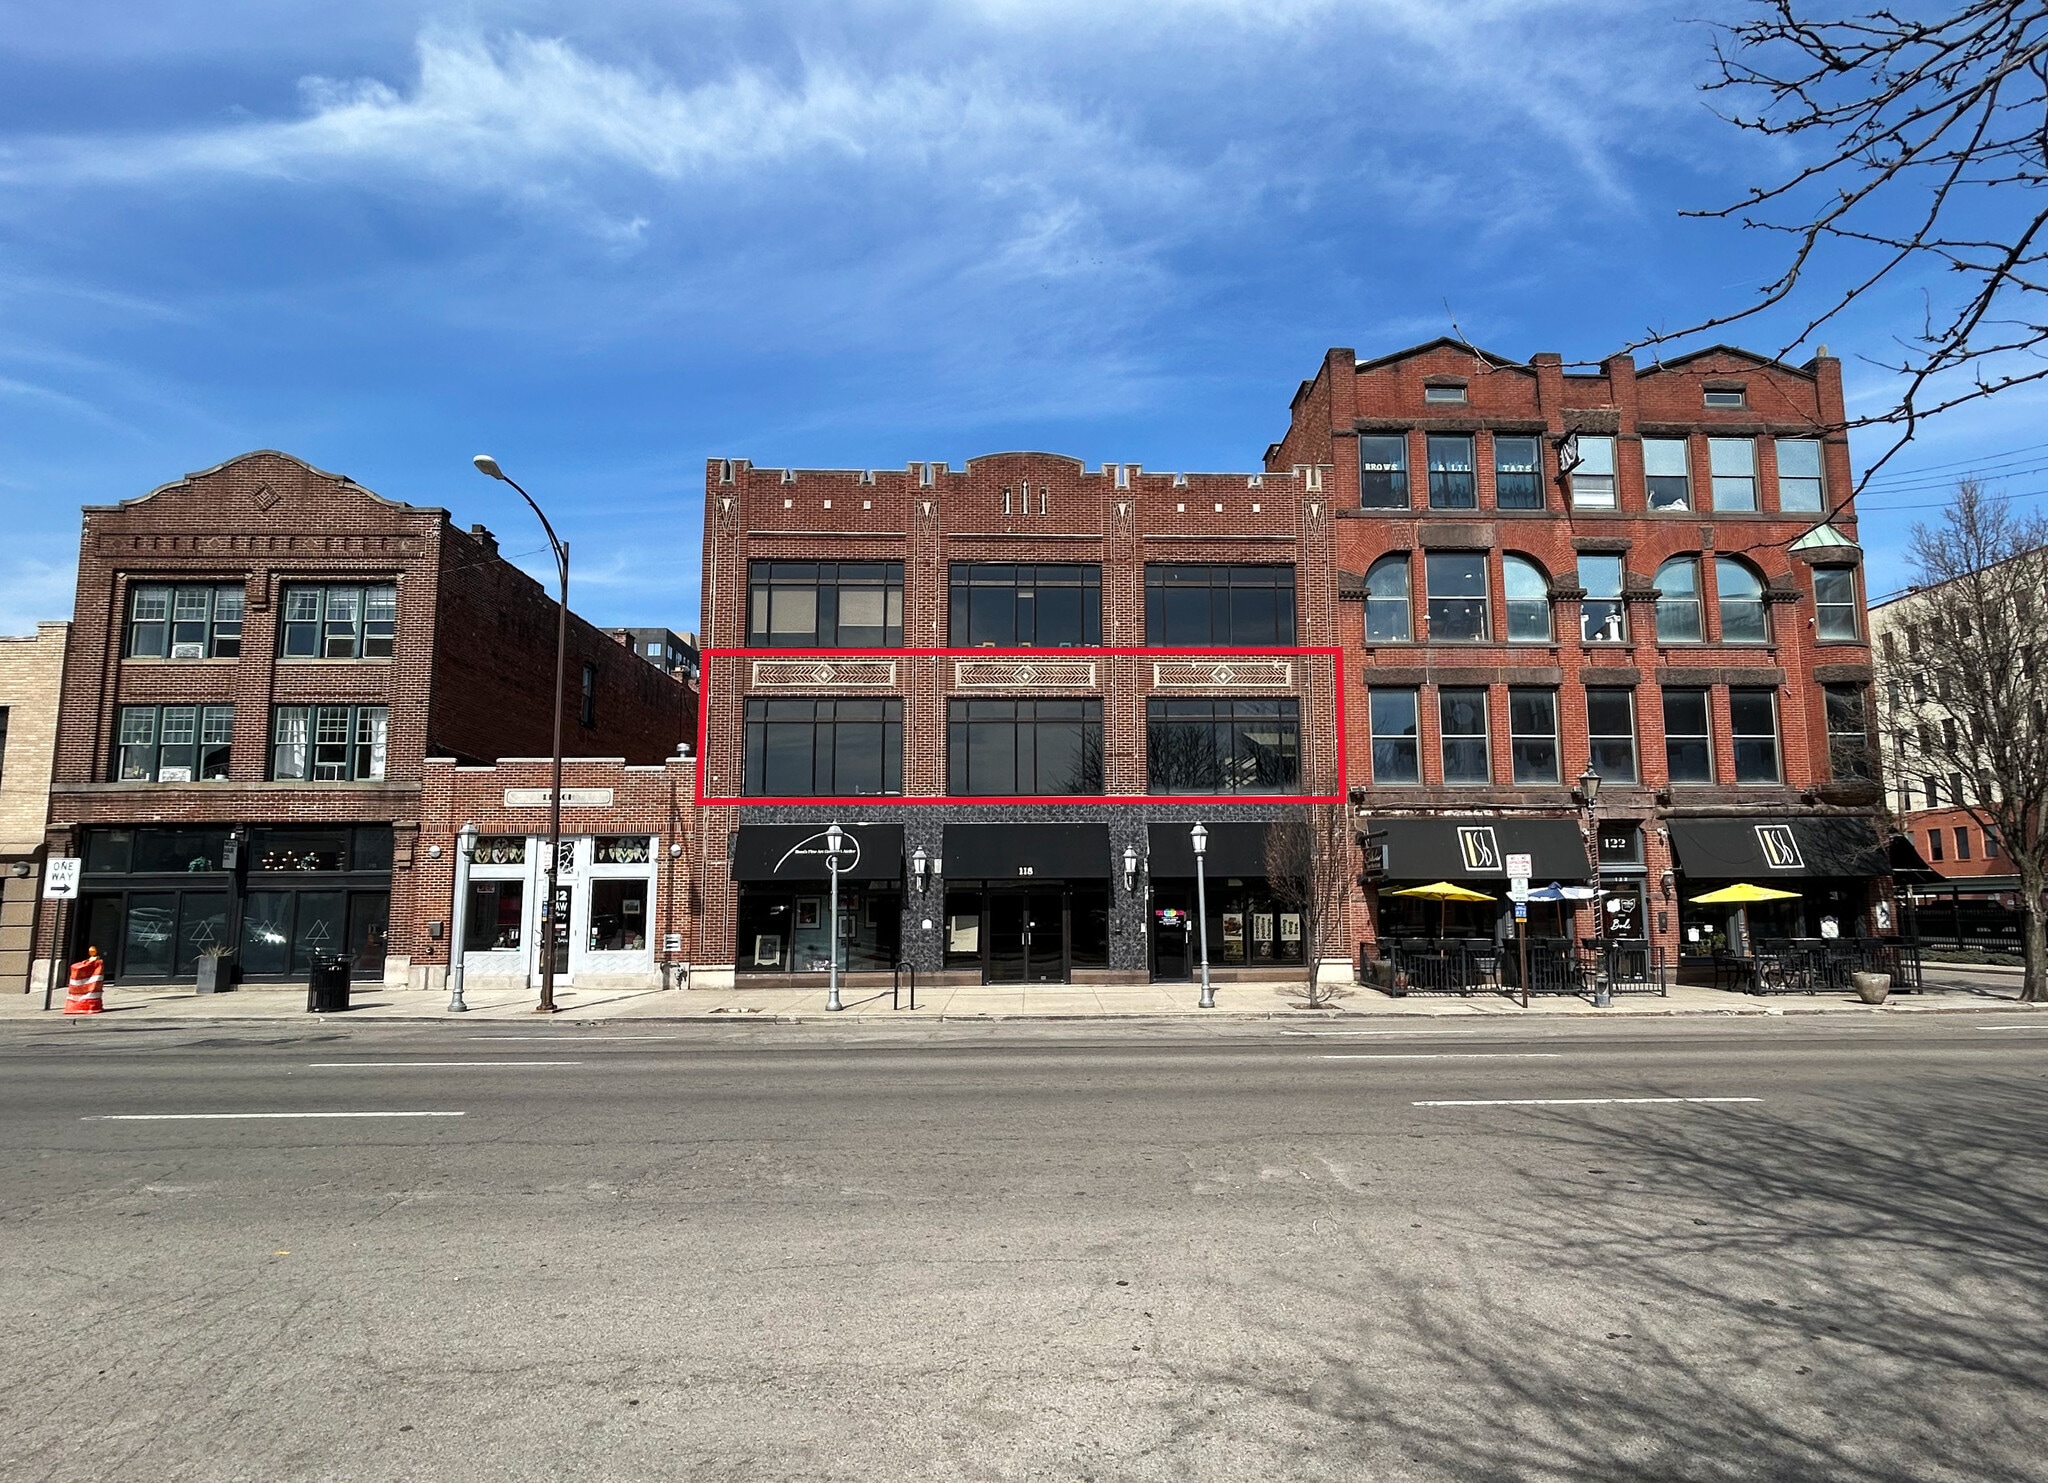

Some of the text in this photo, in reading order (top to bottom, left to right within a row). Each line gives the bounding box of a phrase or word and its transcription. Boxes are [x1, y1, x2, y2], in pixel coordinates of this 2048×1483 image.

[1365, 463, 1532, 472] BROWS & LIL TATS
[1604, 838, 1626, 848] 122
[53, 861, 74, 871] ONE
[1018, 866, 1034, 876] 118
[51, 872, 74, 881] WAY
